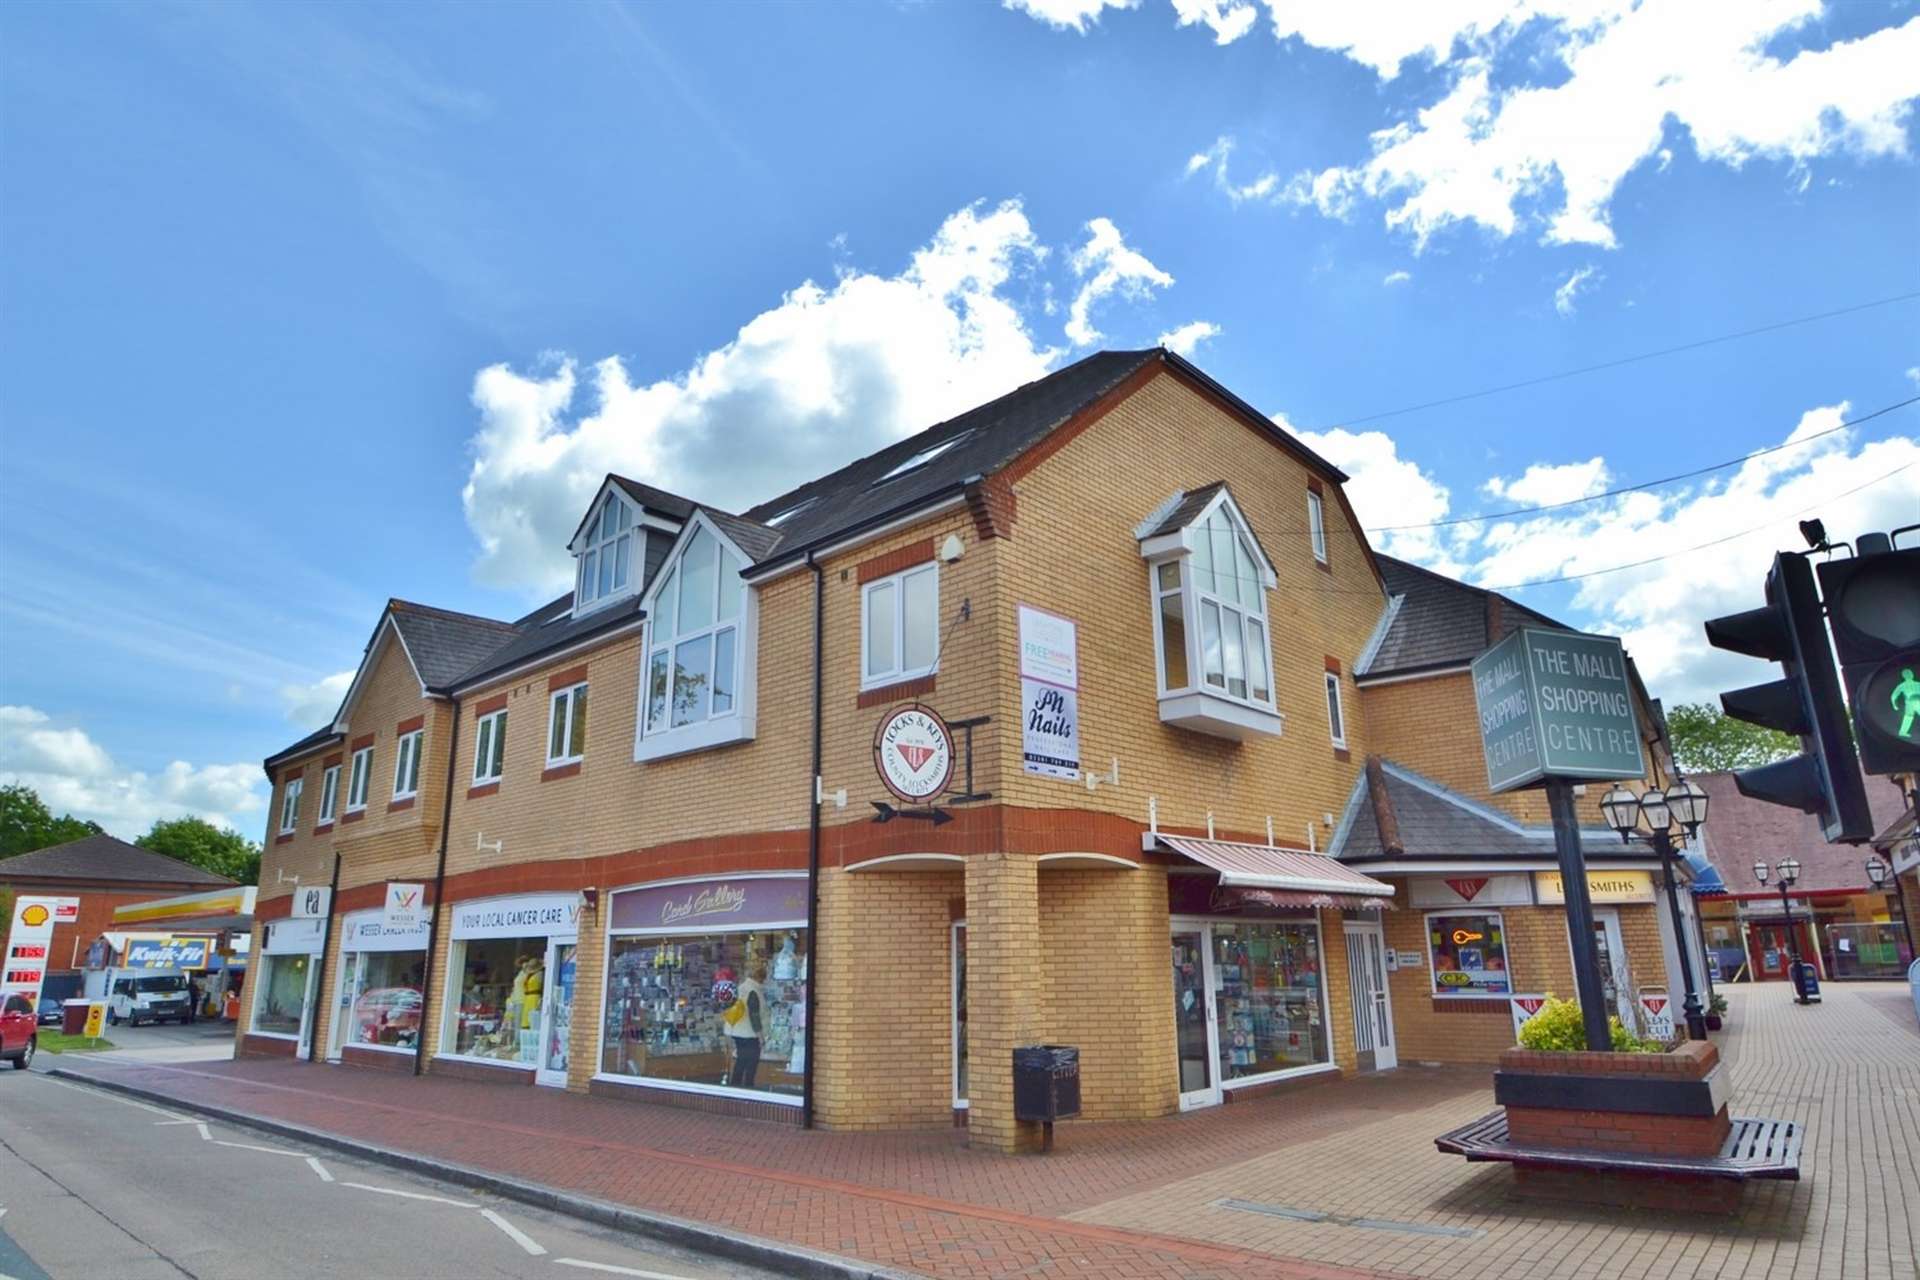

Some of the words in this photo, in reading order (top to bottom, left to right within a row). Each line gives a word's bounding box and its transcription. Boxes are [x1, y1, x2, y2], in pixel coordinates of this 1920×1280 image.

[1025, 642, 1047, 659] FREE
[1534, 648, 1570, 675] THE
[1573, 653, 1621, 680] MALL
[1477, 672, 1494, 698] THE
[1494, 655, 1521, 687] MALL
[1482, 689, 1527, 735] SHOPPING
[1541, 685, 1628, 718] SHOPPING
[885, 714, 914, 743] LOCKS
[916, 717, 925, 727] &
[927, 722, 945, 751] KEYS
[1028, 708, 1071, 738] Nails
[1487, 726, 1535, 769] CENTRE
[1548, 724, 1636, 755] CENTRE
[306, 890, 320, 915] ea
[462, 914, 480, 928] YOUR
[482, 911, 504, 928] LOCAL
[507, 909, 538, 926] CANCER
[541, 908, 562, 924] CARE
[661, 896, 692, 921] Card
[694, 885, 747, 912] Gallery
